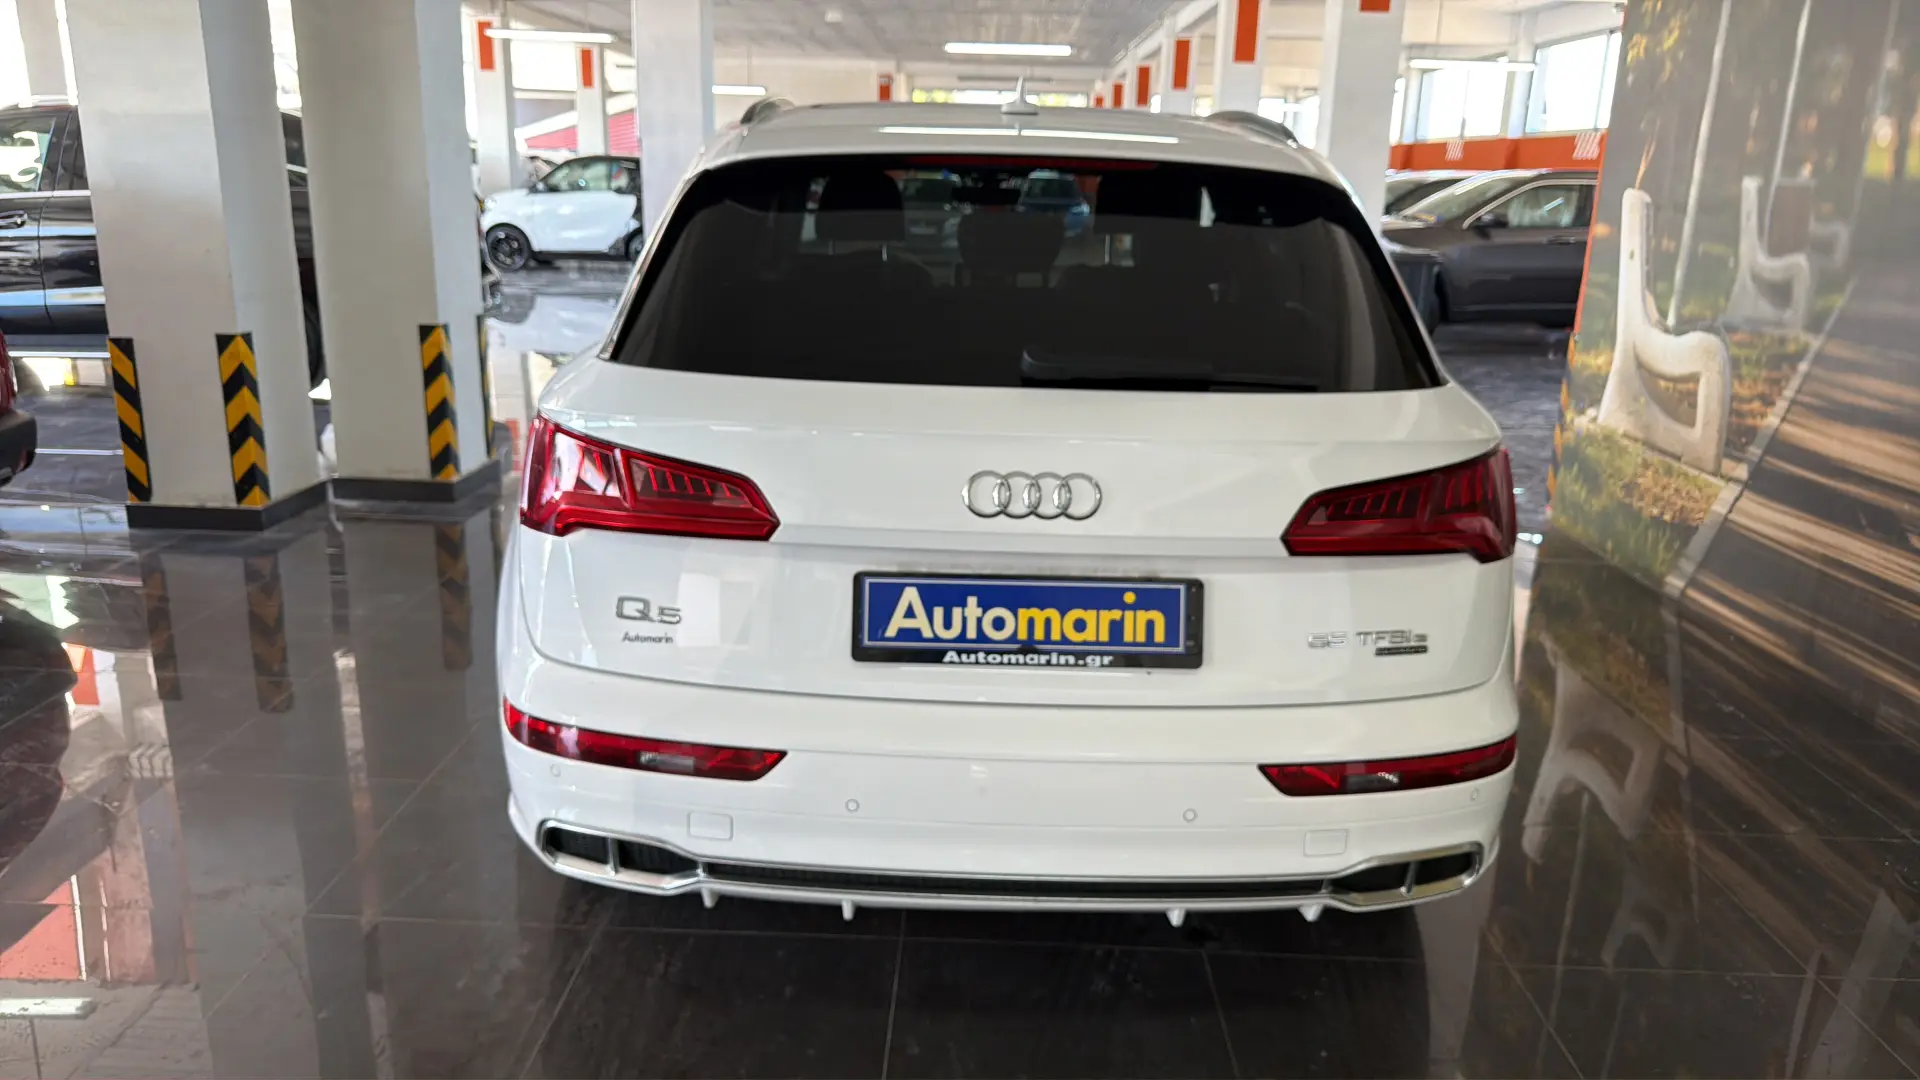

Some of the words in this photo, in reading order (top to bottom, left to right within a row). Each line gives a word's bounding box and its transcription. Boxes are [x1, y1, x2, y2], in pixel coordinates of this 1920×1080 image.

[615, 596, 682, 625] Q5
[884, 586, 1166, 643] Automarin
[621, 631, 674, 644] Automarin
[942, 650, 1113, 667] Automarin.gr
